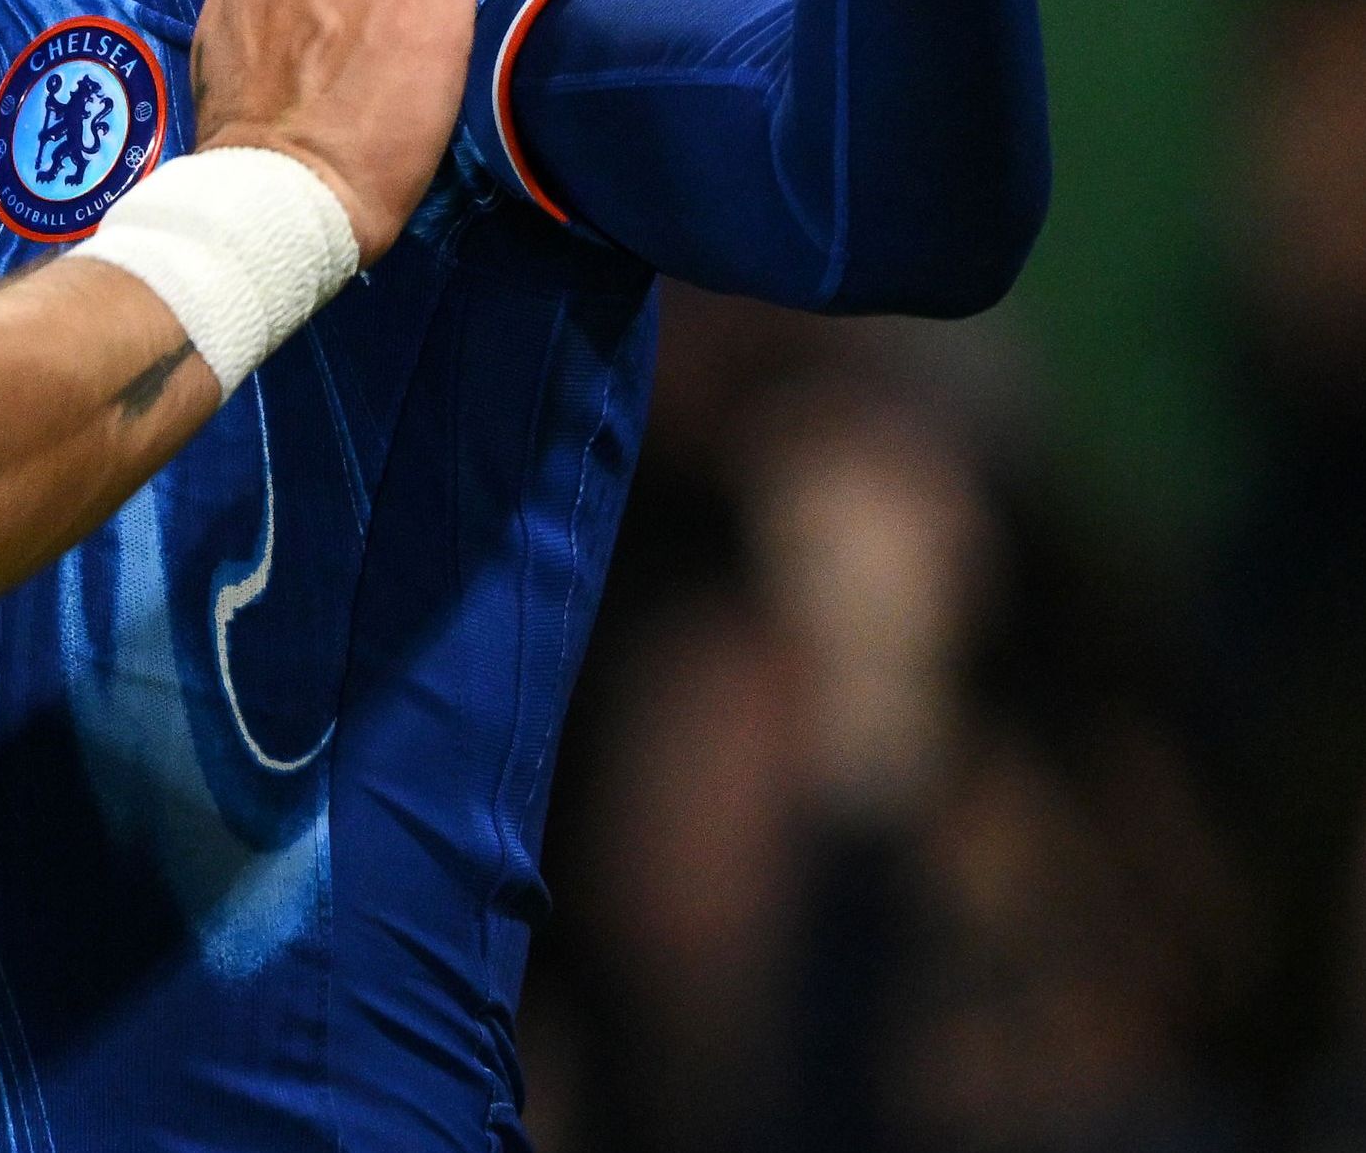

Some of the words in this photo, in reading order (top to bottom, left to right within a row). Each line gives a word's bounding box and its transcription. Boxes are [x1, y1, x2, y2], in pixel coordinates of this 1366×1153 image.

[29, 31, 138, 79] CHELSEA
[1, 186, 67, 226] FOOTBALL
[75, 190, 114, 222] CLUB
